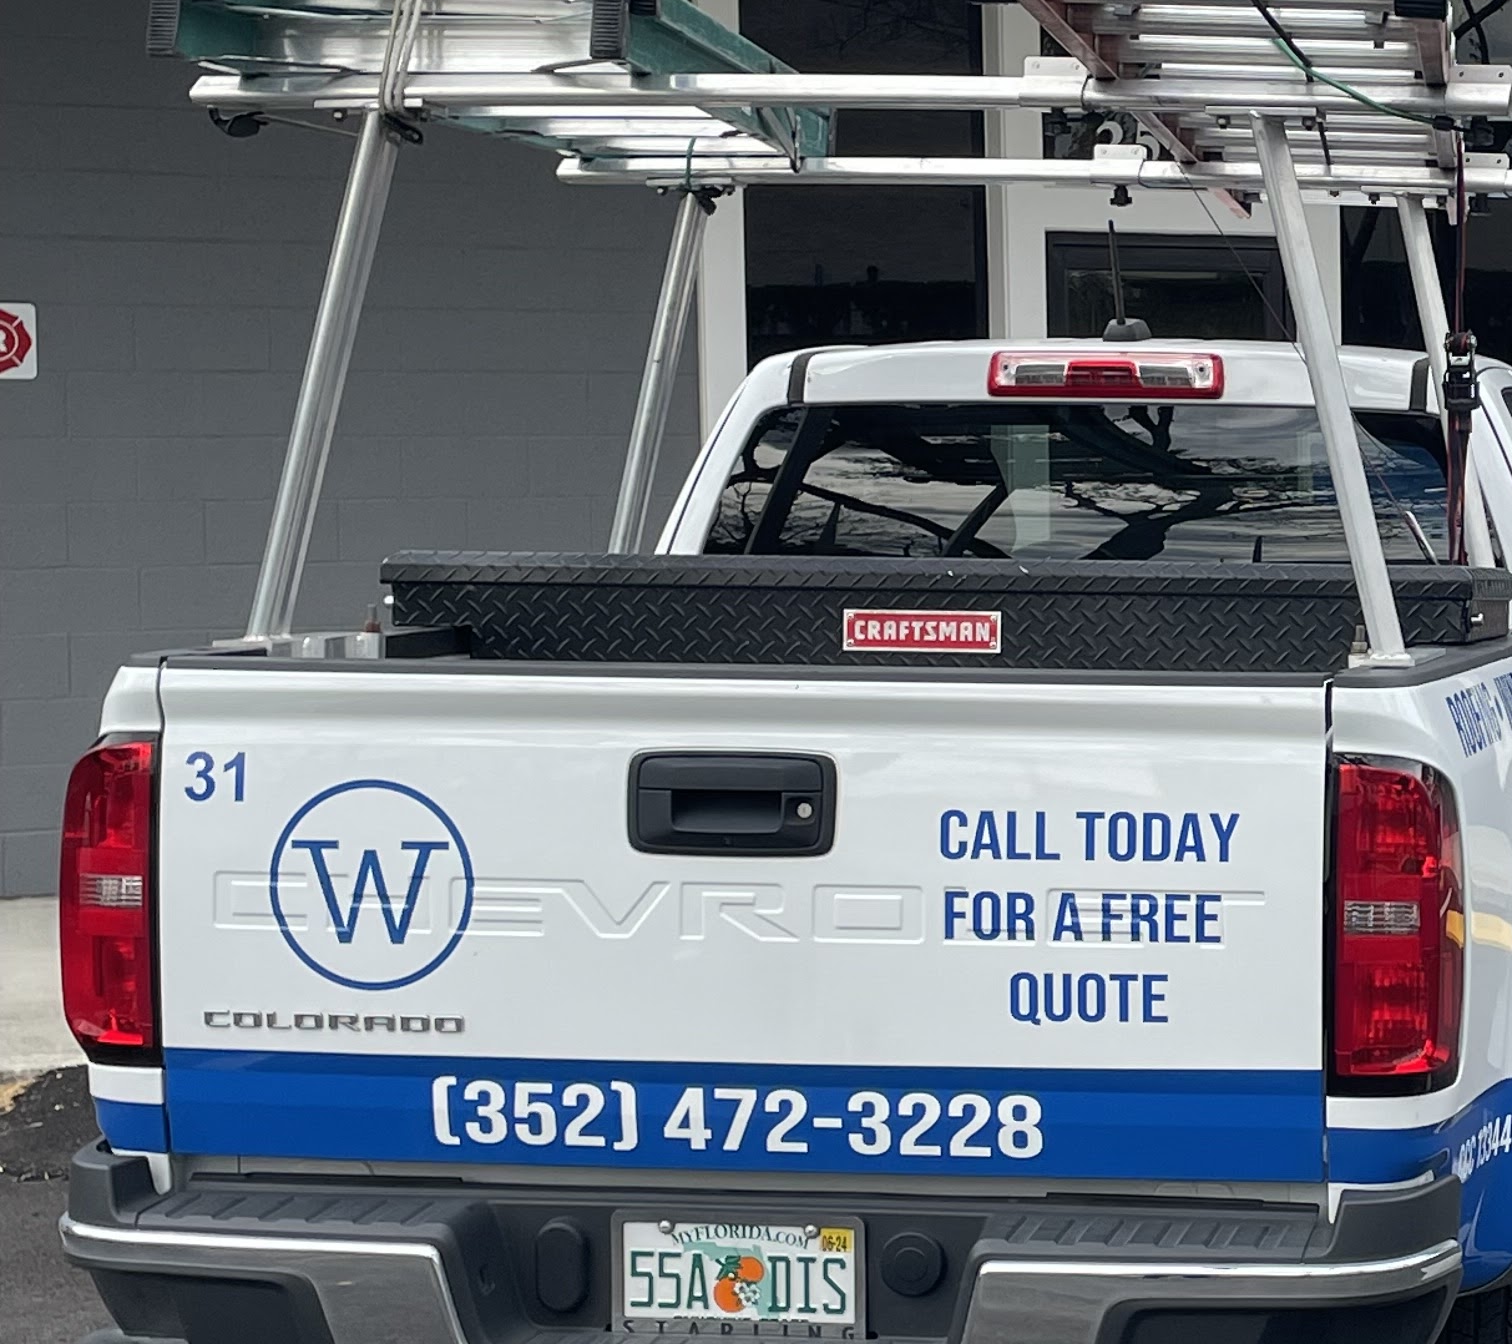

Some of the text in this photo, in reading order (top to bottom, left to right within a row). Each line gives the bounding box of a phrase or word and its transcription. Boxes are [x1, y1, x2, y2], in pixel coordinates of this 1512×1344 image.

[854, 619, 991, 643] CRAFTSMAN
[1446, 682, 1502, 758] ROOFING
[184, 751, 247, 802] 31
[940, 809, 1240, 863] CALL TODAY
[290, 840, 450, 946] W
[944, 890, 1222, 944] FOR A FREE
[203, 1009, 465, 1035] COLORADO
[1010, 973, 1169, 1026] QUOTE
[431, 1075, 1043, 1158] (352) 472-3228
[671, 1224, 809, 1250] MYFLORIDA.COM
[630, 1250, 847, 1314] 55A DIS
